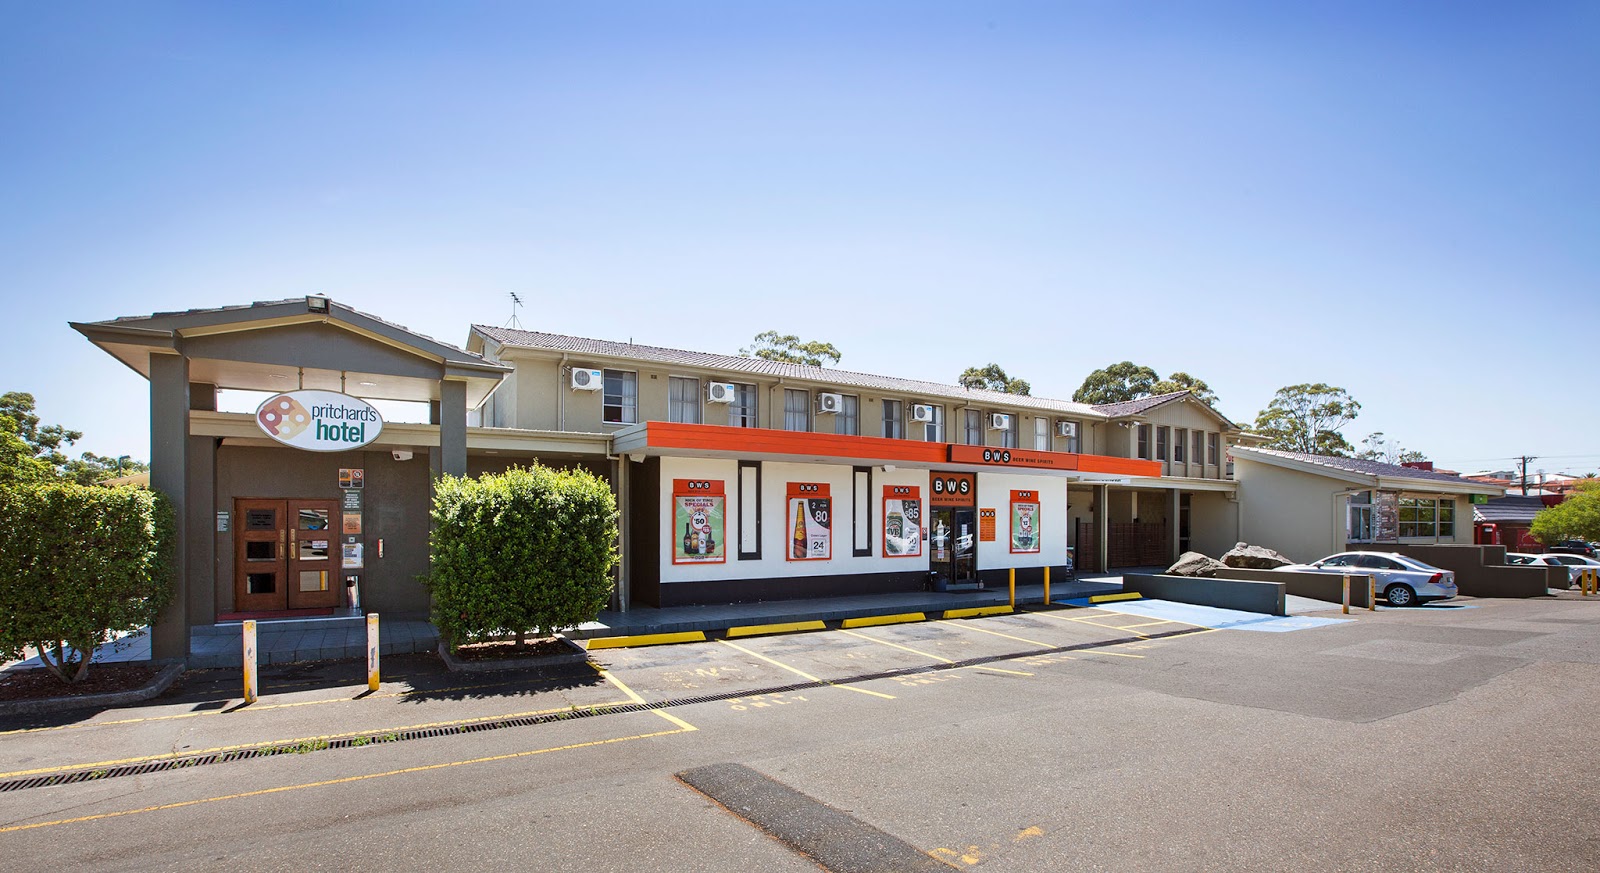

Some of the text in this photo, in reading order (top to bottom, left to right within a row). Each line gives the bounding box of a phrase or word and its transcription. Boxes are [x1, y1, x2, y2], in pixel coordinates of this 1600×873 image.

[312, 403, 377, 422] pritchard's
[316, 418, 365, 443] hotel
[983, 450, 1010, 462] BWS
[934, 479, 969, 493] BWS
[813, 541, 824, 550] 24
[731, 695, 808, 711] ONLY
